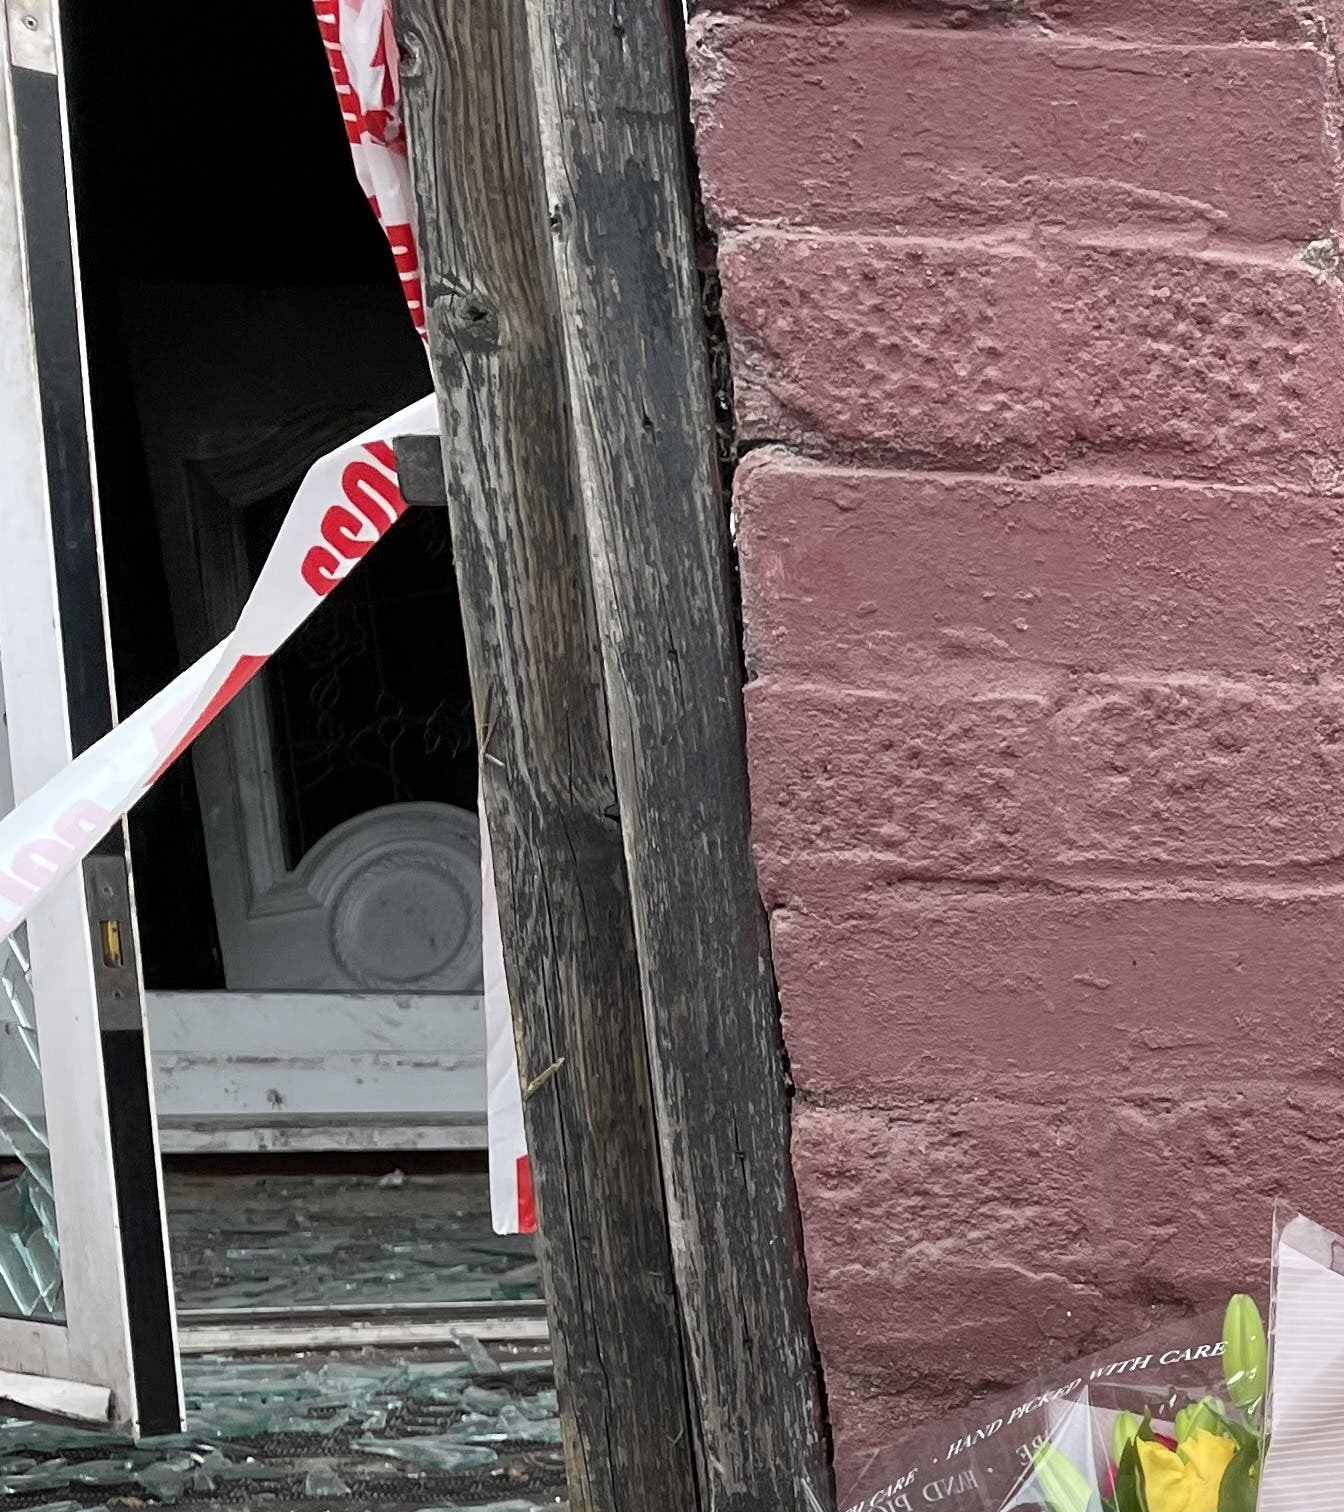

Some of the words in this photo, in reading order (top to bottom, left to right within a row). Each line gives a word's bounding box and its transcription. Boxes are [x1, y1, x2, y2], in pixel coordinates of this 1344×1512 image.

[946, 1418, 1004, 1461] HAND
[1006, 1377, 1082, 1426] PICKED
[1089, 1353, 1153, 1382] WITH
[1159, 1341, 1229, 1367] CARE
